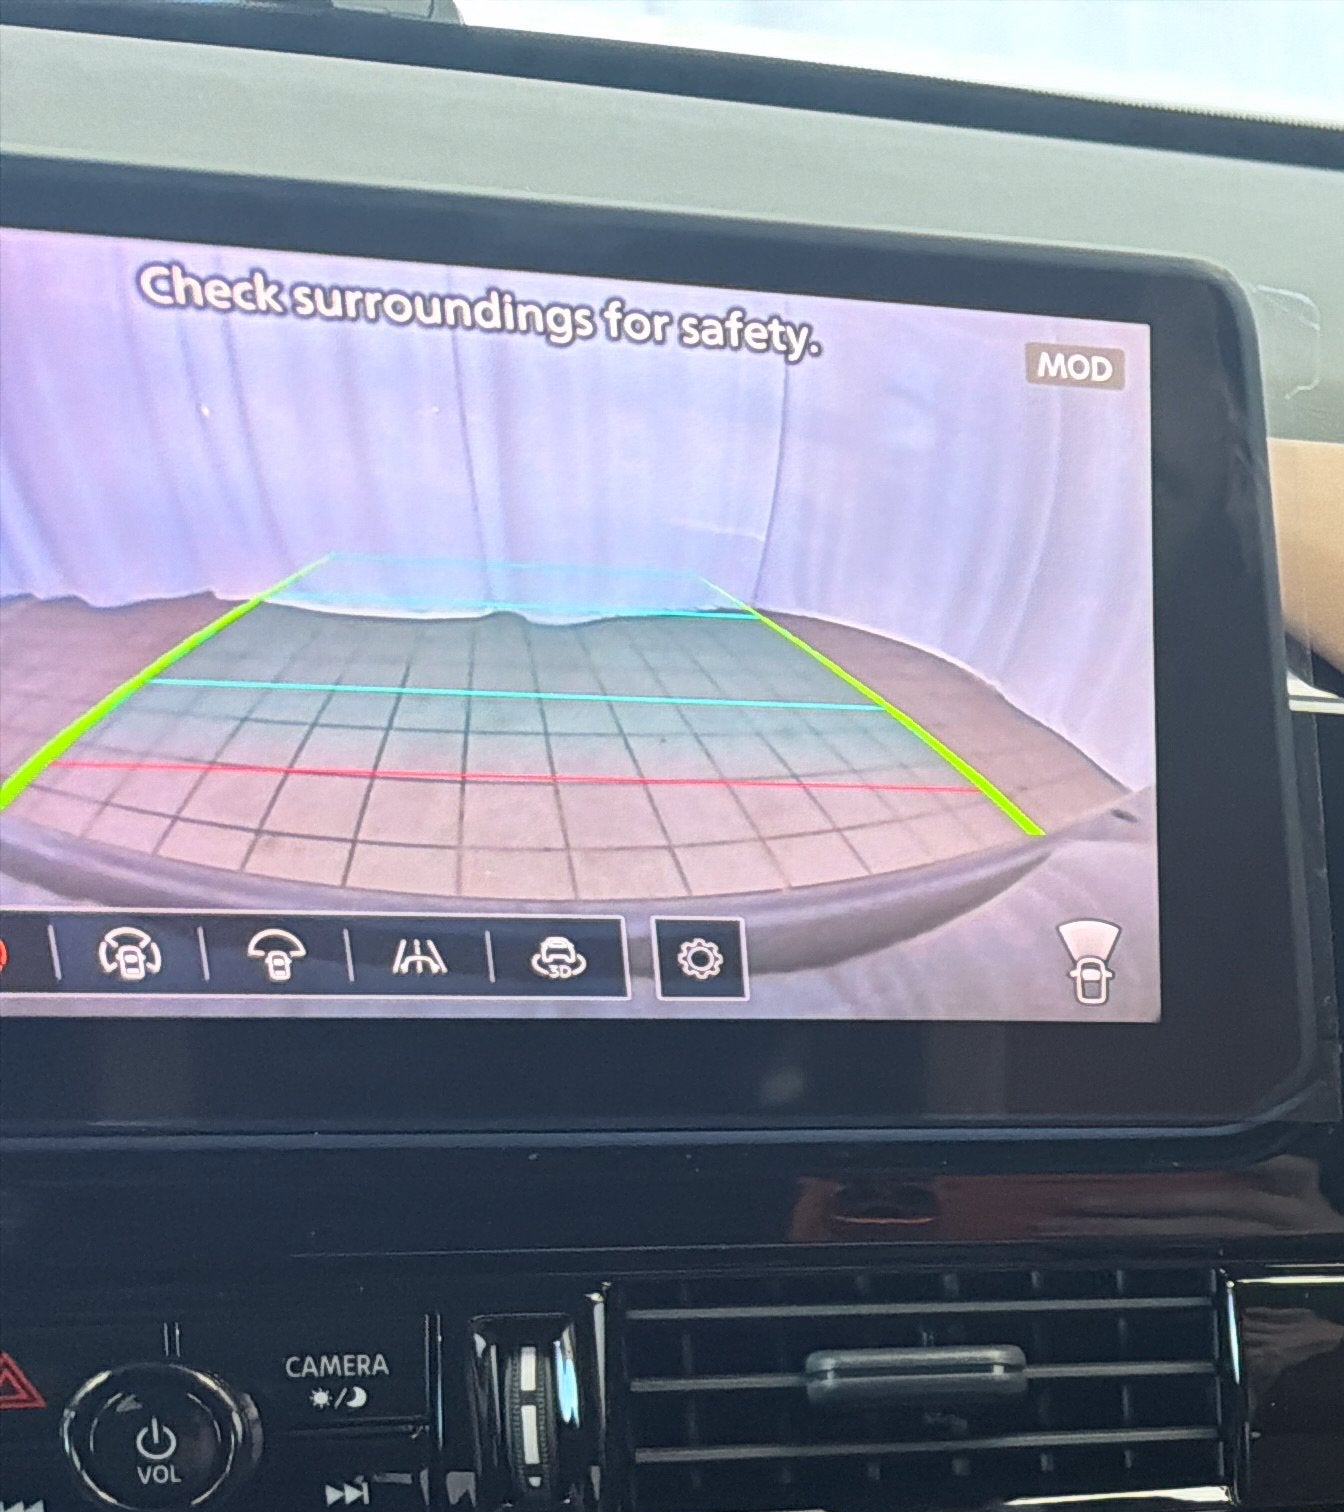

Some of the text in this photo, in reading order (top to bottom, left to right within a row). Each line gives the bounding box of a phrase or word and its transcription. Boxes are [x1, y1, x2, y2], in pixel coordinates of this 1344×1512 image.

[140, 265, 823, 360] Check surroundings for safety.
[1037, 351, 1113, 382] MOD
[548, 964, 572, 979] 3D
[285, 1353, 390, 1378] CAMERA
[136, 1464, 182, 1485] VOL
